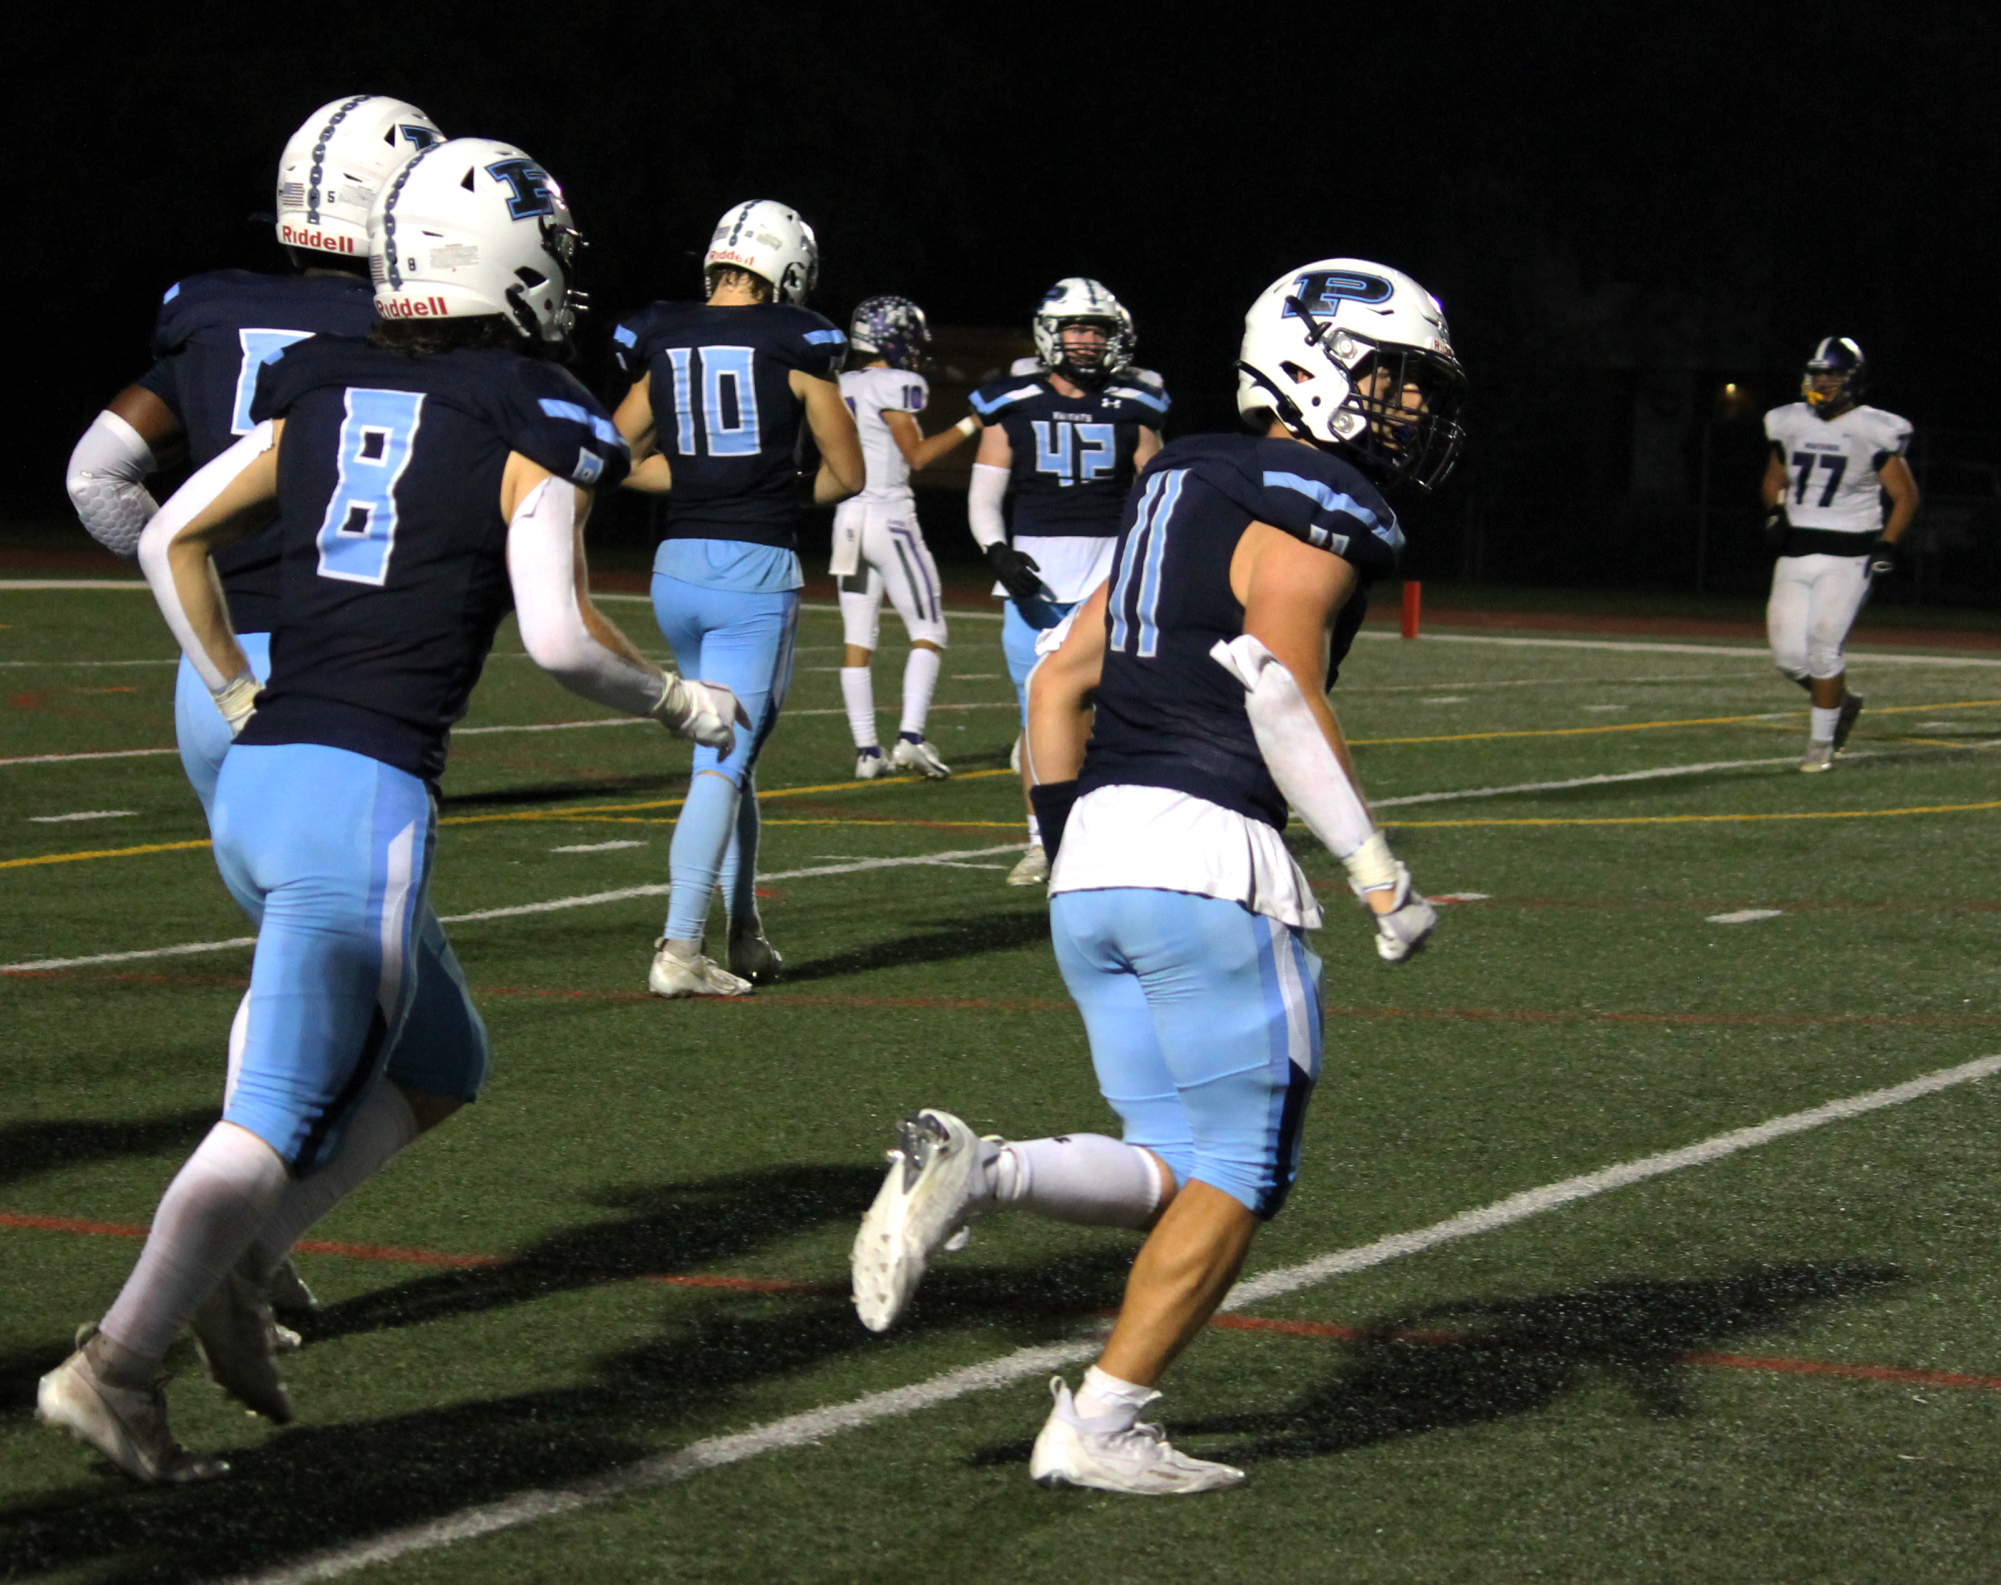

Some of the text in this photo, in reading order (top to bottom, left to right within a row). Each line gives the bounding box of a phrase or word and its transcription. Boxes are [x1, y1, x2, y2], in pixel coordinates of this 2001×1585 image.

[327, 191, 336, 203] 5
[282, 225, 354, 254] Riddell
[407, 257, 417, 272] 8
[375, 296, 449, 319] Riddell
[1281, 269, 1394, 319] P
[665, 345, 762, 456] 10
[902, 384, 923, 410] 10
[1031, 420, 1117, 488] 42
[1792, 450, 1849, 508] 77
[317, 386, 428, 587] 8
[1109, 467, 1194, 658] 11
